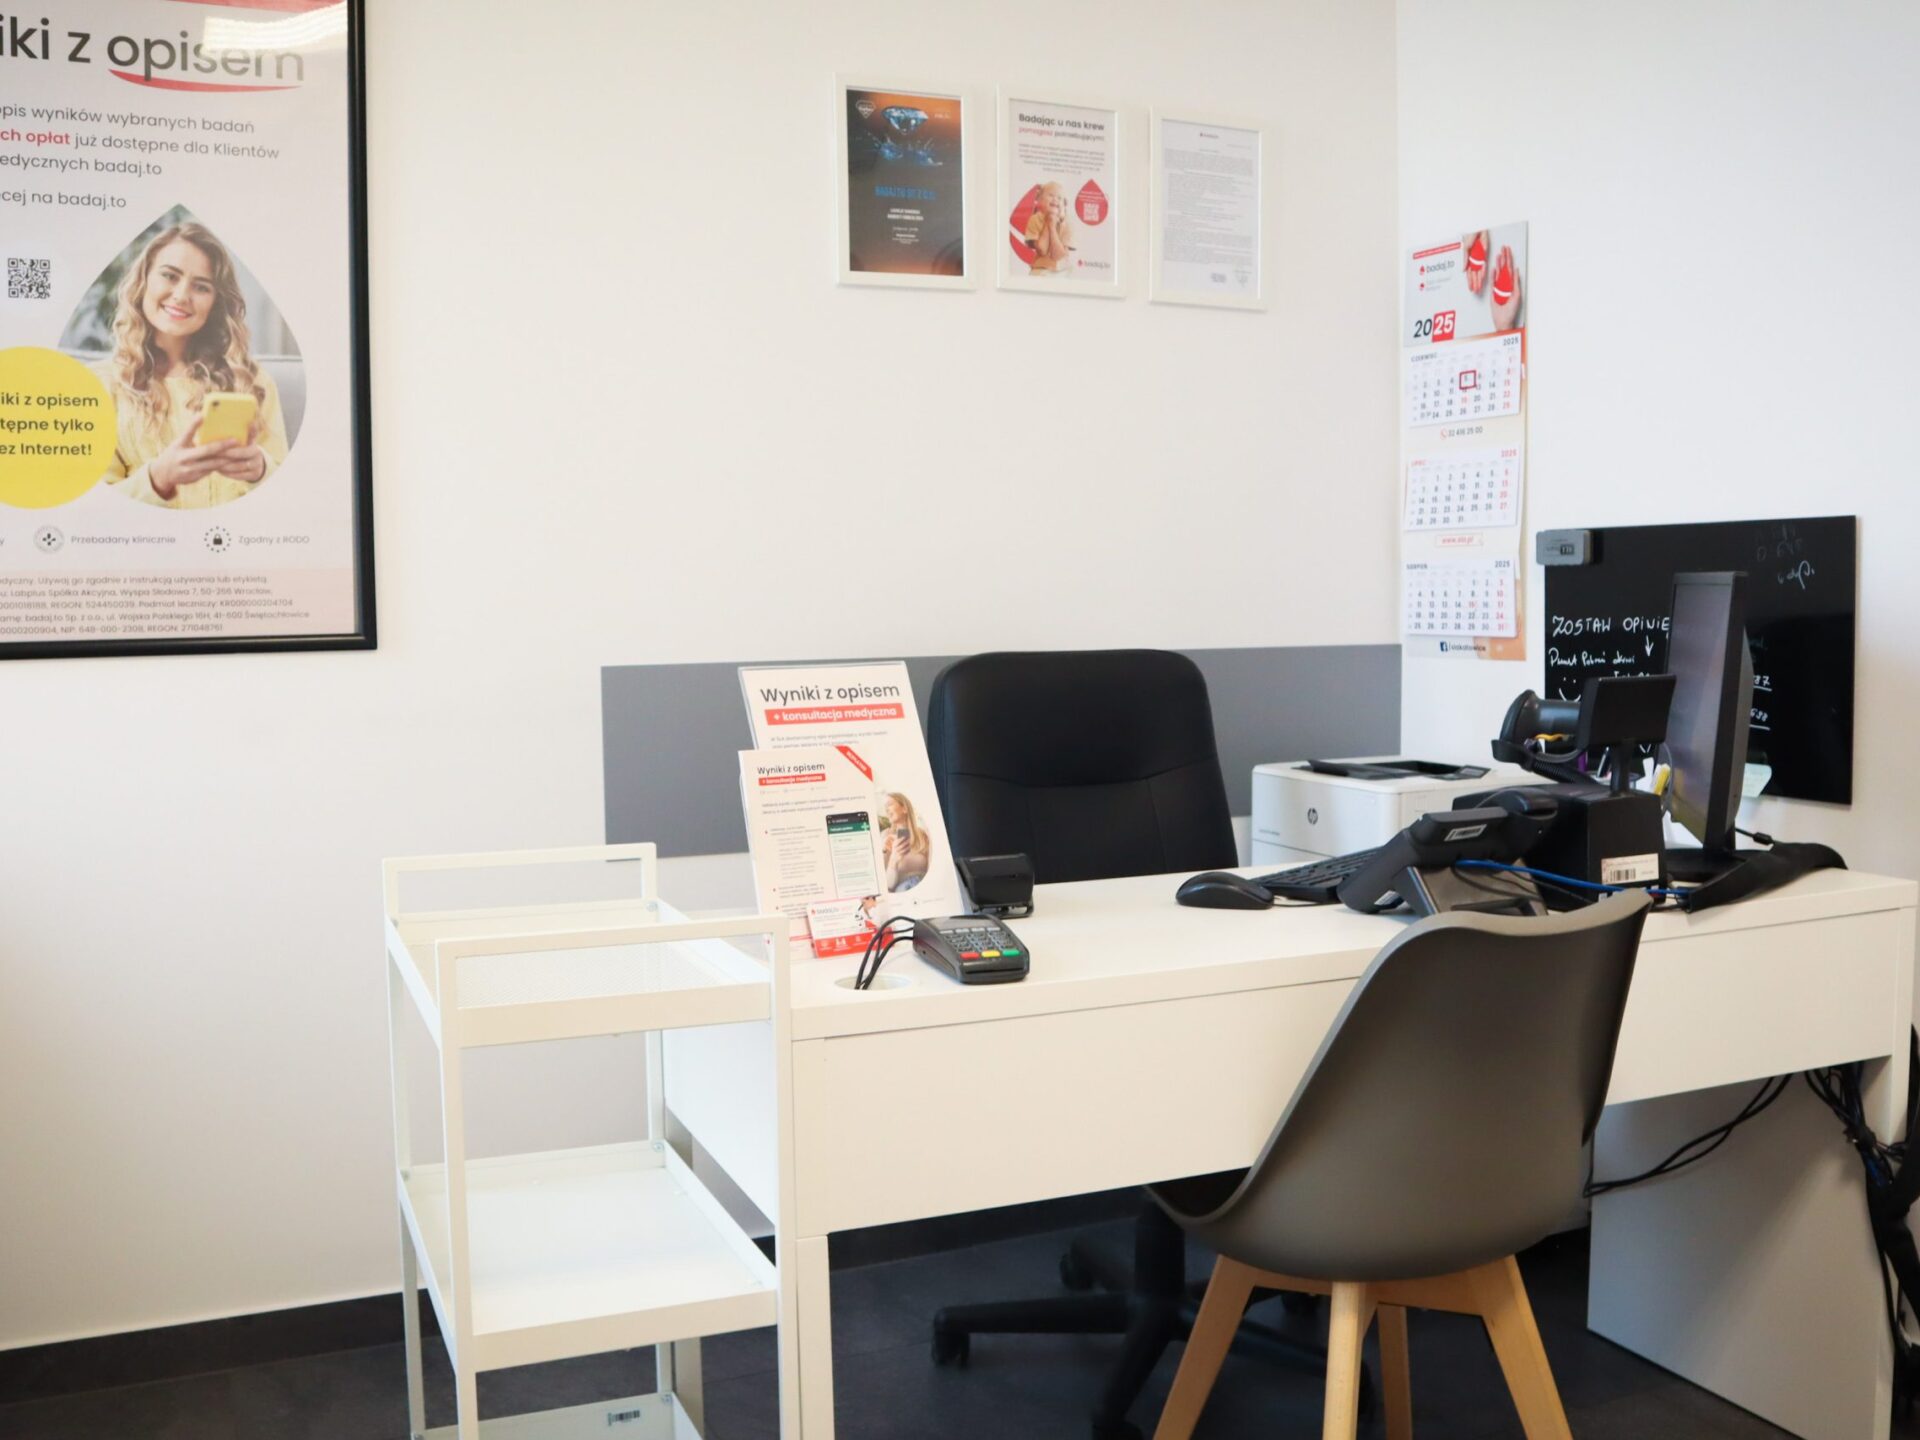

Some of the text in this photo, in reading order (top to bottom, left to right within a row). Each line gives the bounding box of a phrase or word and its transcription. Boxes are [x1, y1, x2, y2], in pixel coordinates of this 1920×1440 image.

[67, 31, 91, 63] z
[107, 30, 304, 82] opisem
[0, 103, 255, 134] pis wyników wybranych badań
[1018, 113, 1105, 131] Badając u nas krew
[25, 132, 71, 147] opłat
[74, 133, 97, 150] już
[101, 135, 179, 155] dostępne
[184, 141, 209, 155] dla
[213, 143, 280, 159] Klientów
[94, 159, 162, 178] badaj.to
[31, 192, 53, 204] na
[58, 192, 127, 211] badaj.to
[1413, 313, 1455, 338] 2025
[1503, 337, 1519, 346] 2025
[24, 395, 31, 406] z
[36, 393, 99, 410] opisem
[53, 418, 94, 435] tylko
[20, 443, 92, 456] Internet!
[1501, 449, 1517, 457] 2025
[71, 535, 176, 546] Przebadany klinicznie
[238, 535, 273, 546] Zgodny
[276, 536, 281, 544] z
[71, 578, 84, 587] go
[86, 576, 120, 587] zgodnie
[129, 576, 173, 587] instrukcją
[217, 575, 231, 584] lub
[48, 588, 79, 598] Spółka
[119, 587, 150, 598] Wyspa
[152, 586, 190, 596] Słodowa
[139, 599, 175, 609] Podmiot
[119, 612, 151, 623] Wojska
[152, 611, 194, 623] Polskiego
[1552, 615, 1611, 637] ZOSTAW
[761, 683, 900, 706] Wyniki z opisem
[782, 708, 842, 721] konsultacja
[845, 706, 897, 720] medyczna
[757, 765, 785, 777] Wyniki
[792, 763, 825, 774] opisem
